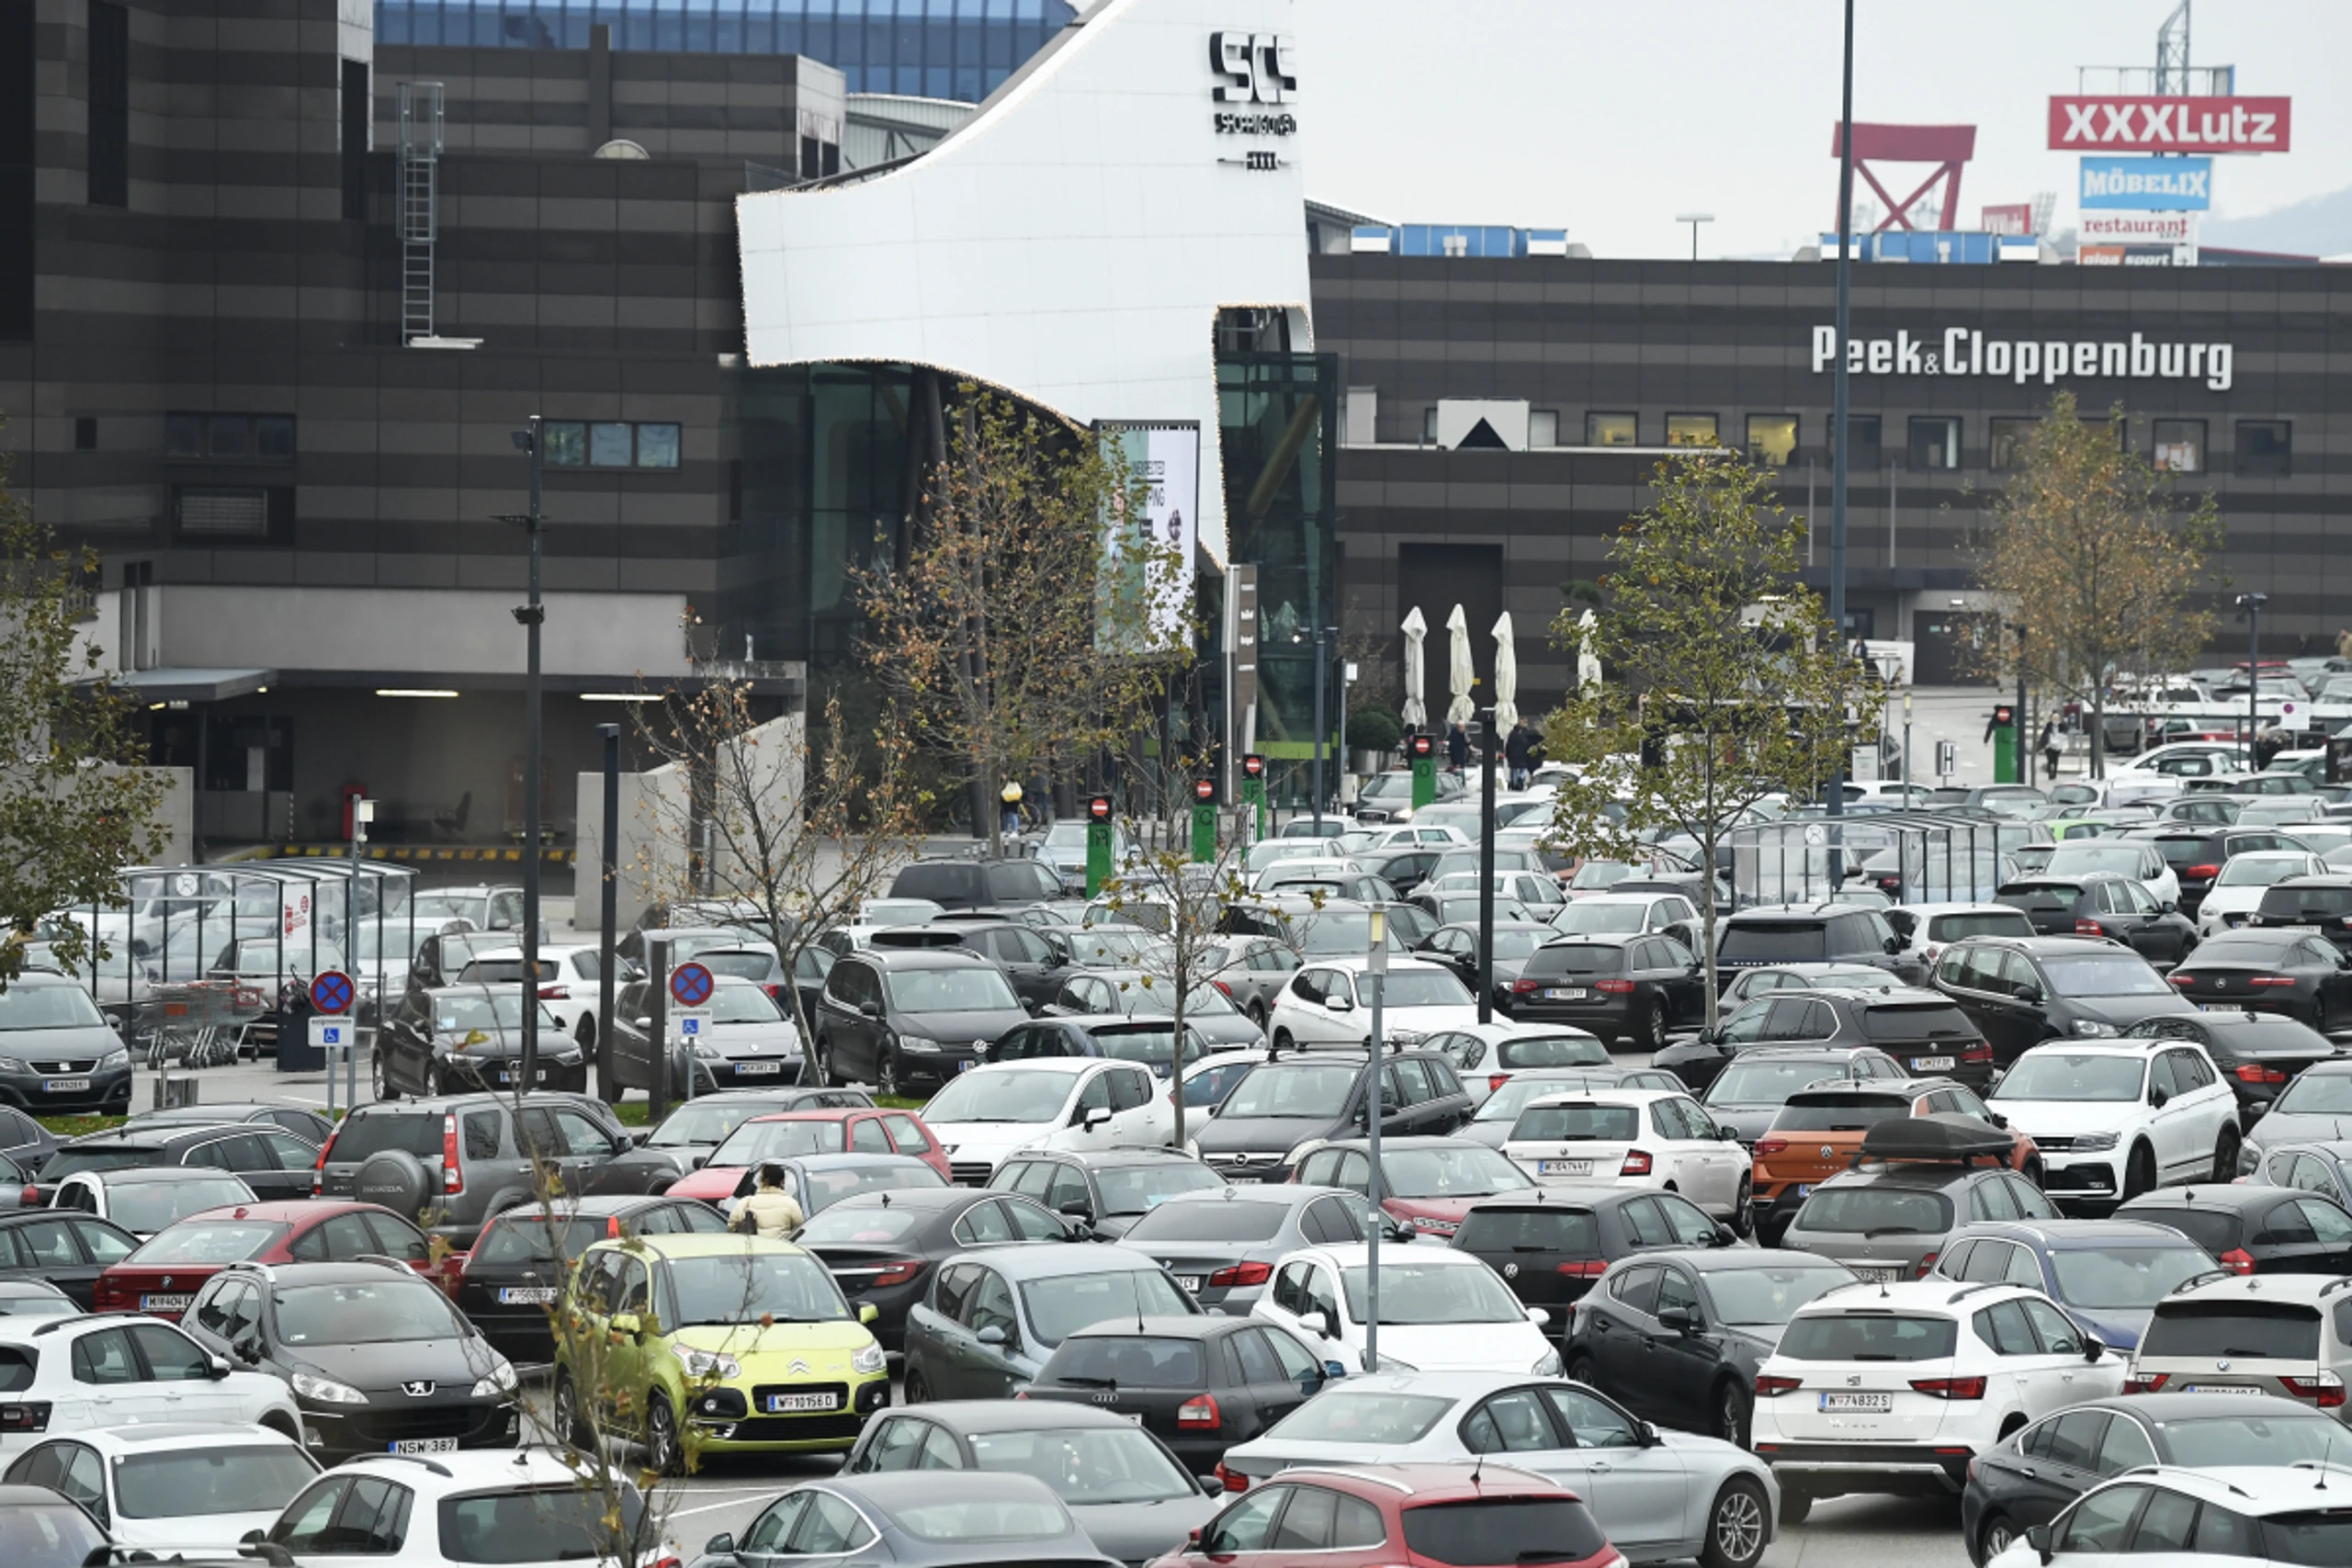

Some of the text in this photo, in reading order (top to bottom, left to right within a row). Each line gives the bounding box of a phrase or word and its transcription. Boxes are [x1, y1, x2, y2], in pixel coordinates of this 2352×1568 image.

[1209, 30, 1296, 103] SCS
[2063, 104, 2278, 143] XXXLutz
[2083, 167, 2208, 198] MÖBELIX
[2084, 217, 2188, 238] restaurant
[2124, 254, 2170, 265] sport
[362, 1185, 404, 1193] HONDA
